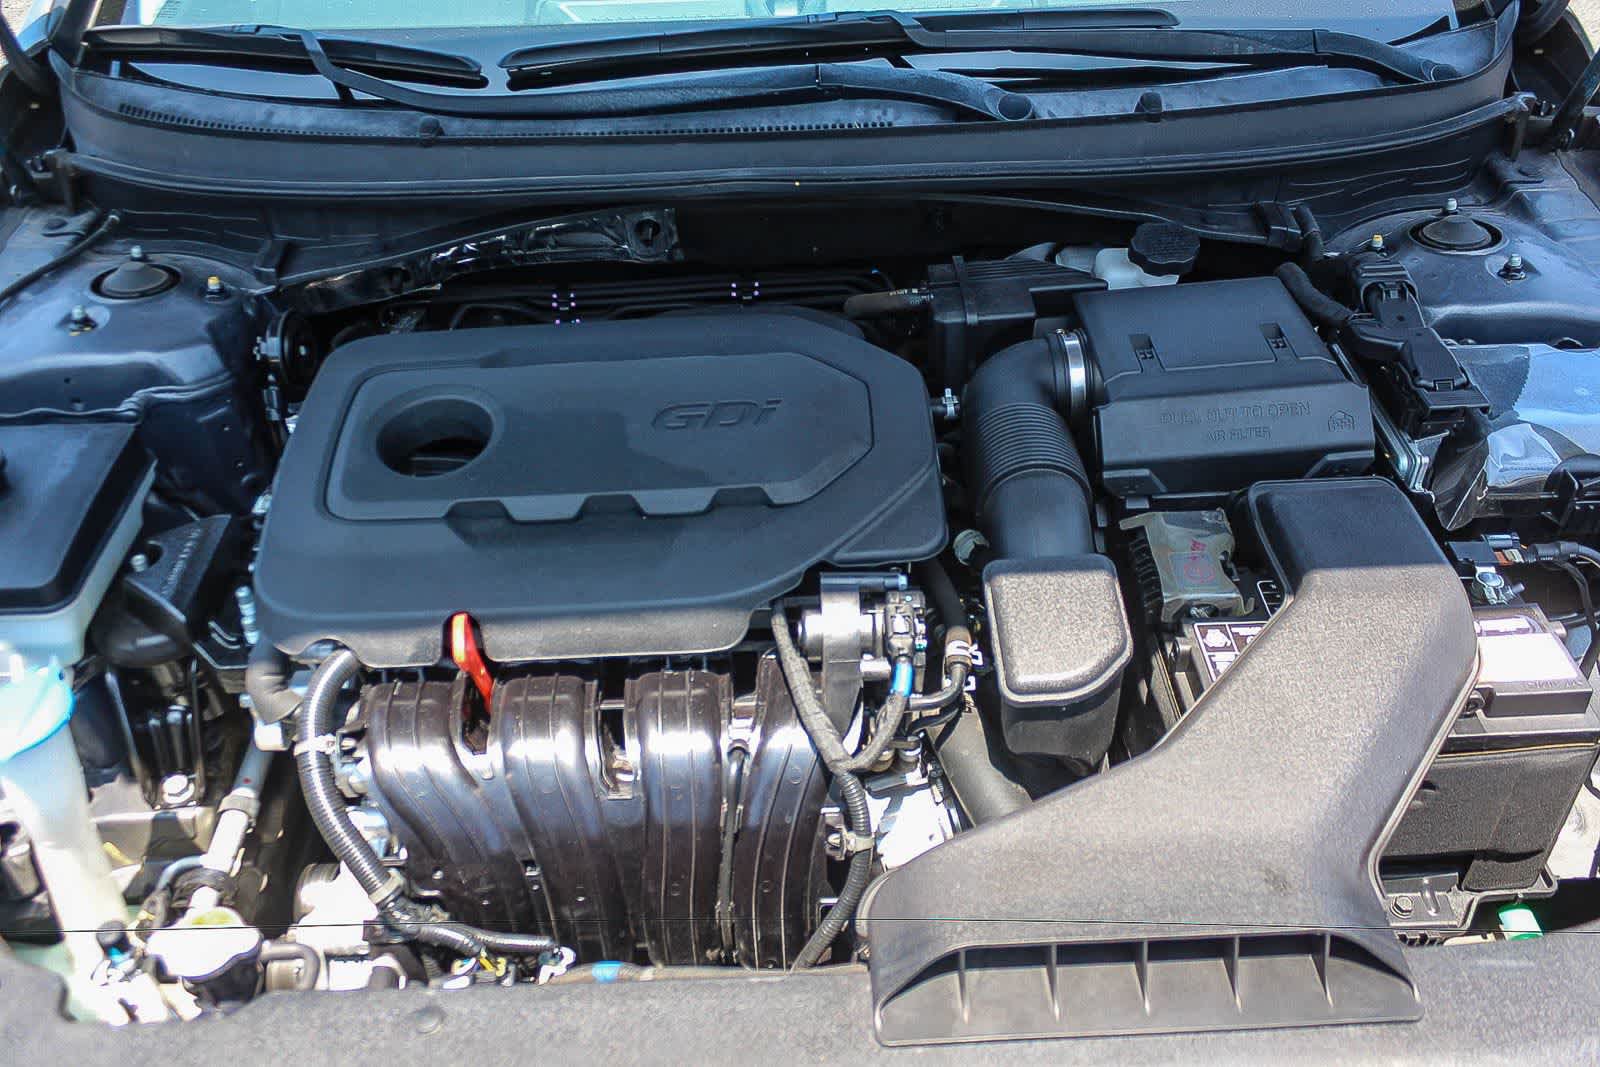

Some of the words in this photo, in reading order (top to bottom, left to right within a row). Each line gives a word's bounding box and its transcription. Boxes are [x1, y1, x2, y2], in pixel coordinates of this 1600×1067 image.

[1240, 403, 1263, 420] TO
[1267, 400, 1312, 418] OPEN
[1208, 428, 1226, 441] AIR
[1230, 425, 1271, 441] FILTER
